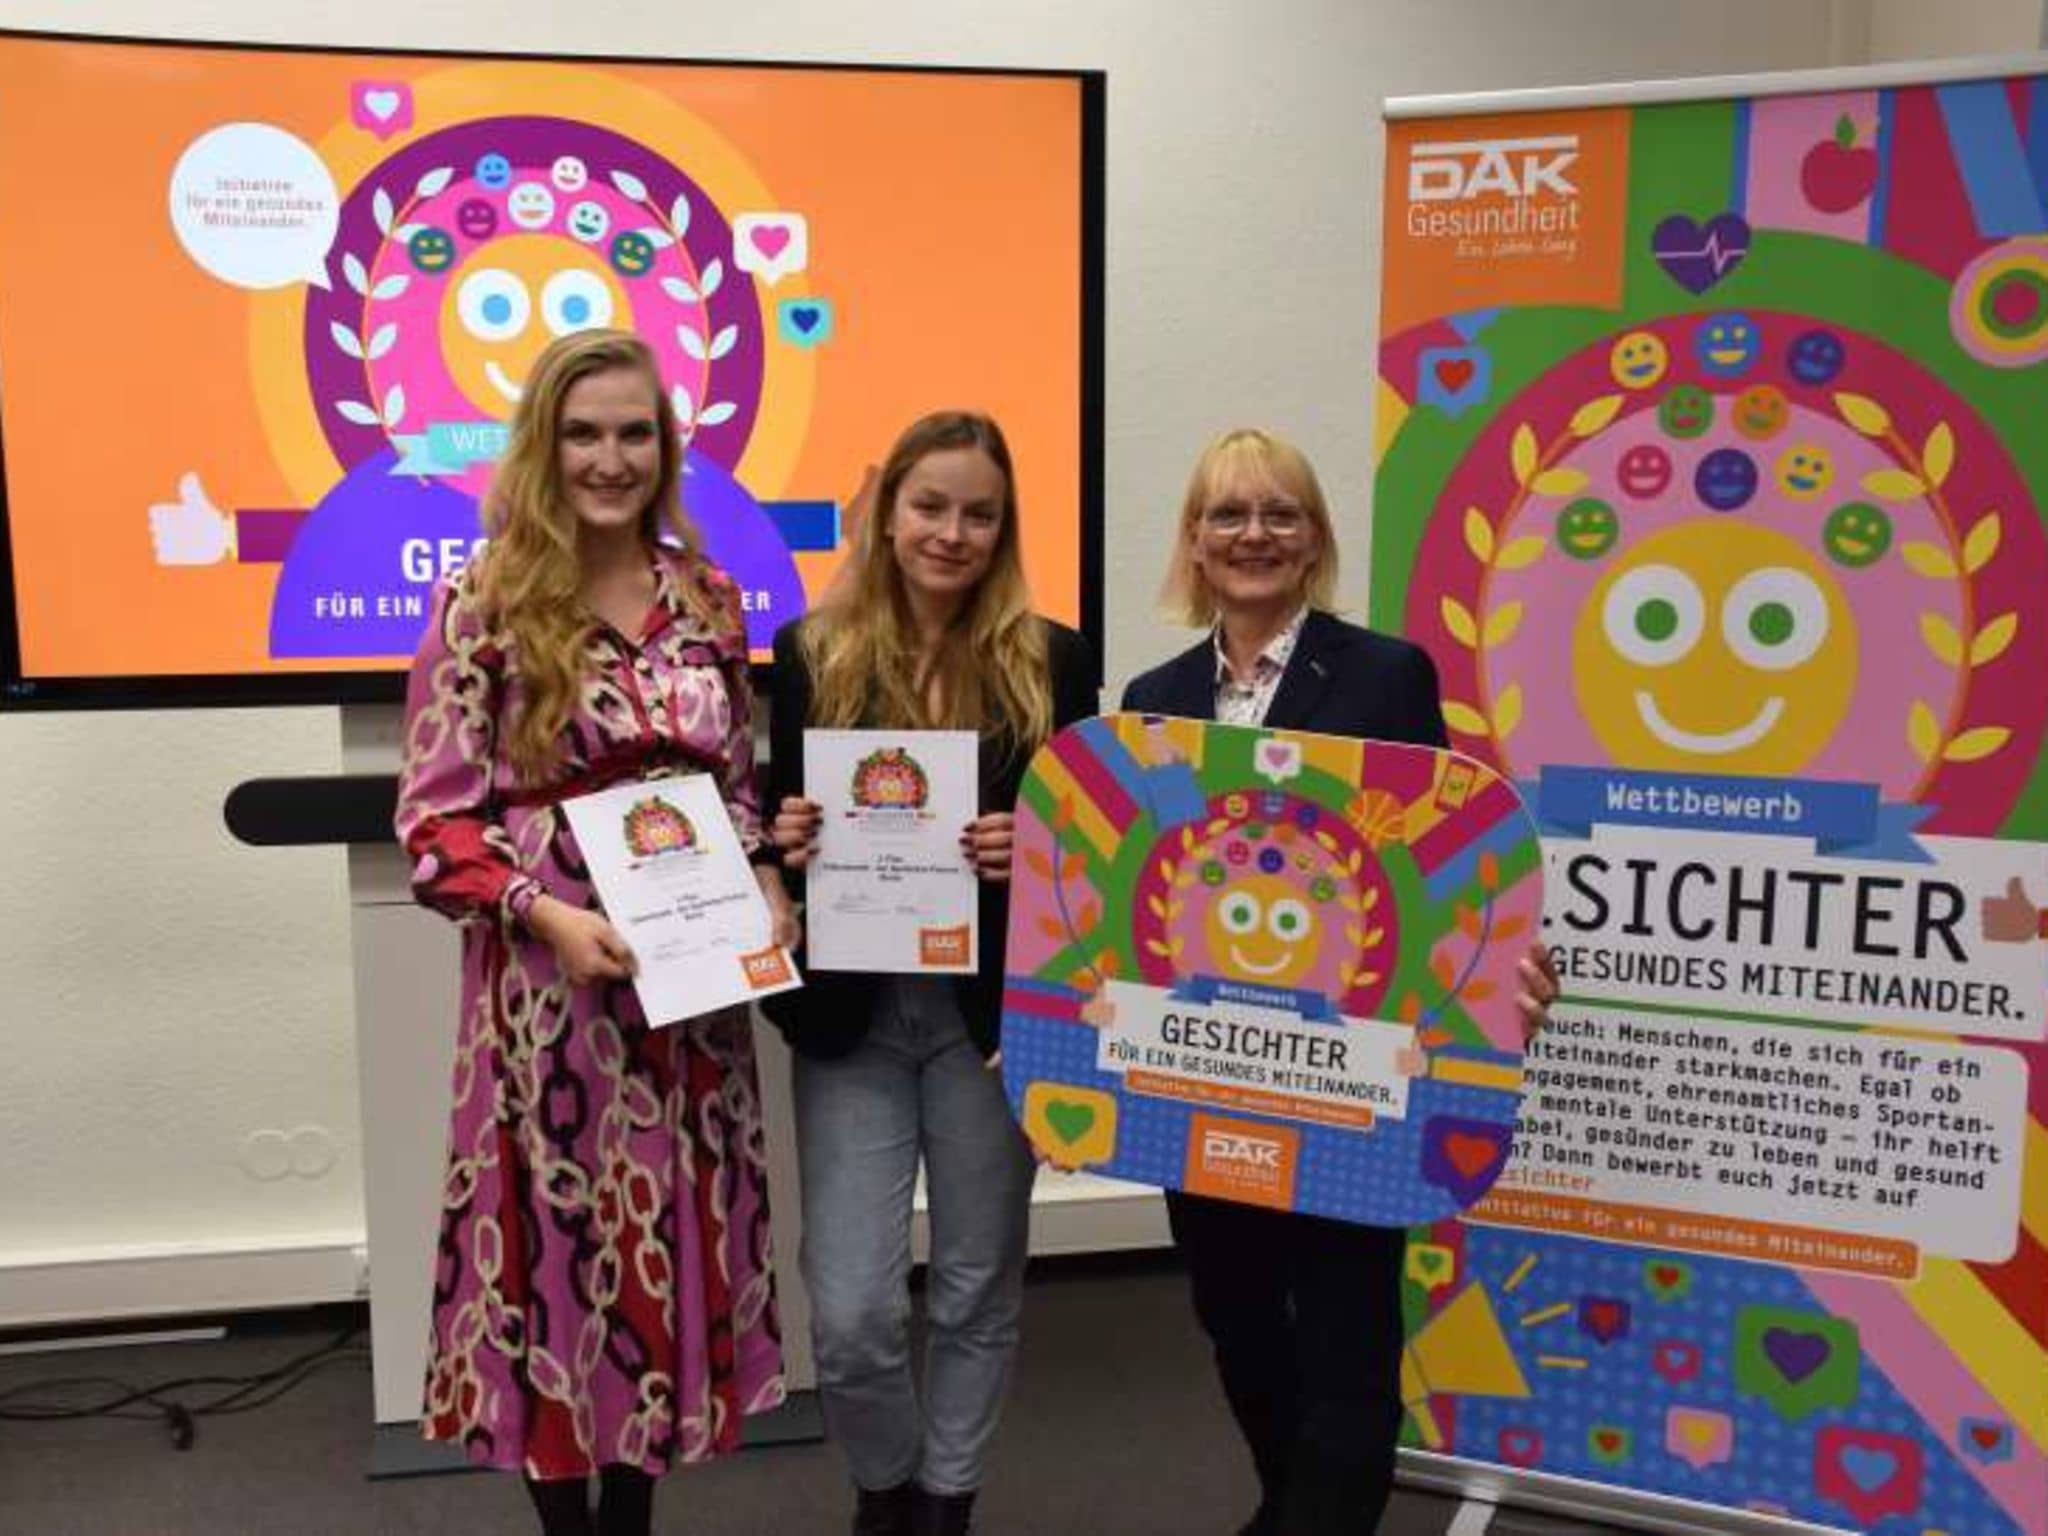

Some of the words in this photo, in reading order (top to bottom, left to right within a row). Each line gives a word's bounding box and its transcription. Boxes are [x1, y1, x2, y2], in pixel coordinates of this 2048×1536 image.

[1408, 134, 1579, 201] DAK
[1407, 198, 1578, 236] Gesundheit
[316, 594, 364, 618] FÜR
[378, 596, 422, 617] EIN
[1606, 783, 1803, 822] Wettbewerb
[1543, 853, 1969, 965] SICHTER
[1743, 962, 2027, 1021] MITEINANDER.
[1145, 1045, 1177, 1066] EIN
[1181, 1054, 1267, 1084] GESUNDES
[1160, 1013, 1348, 1072] GESICHTER
[1752, 1036, 1792, 1058] die
[1808, 1040, 1863, 1066] sich
[1879, 1049, 1922, 1073] für
[1937, 1058, 1981, 1078] ein
[1674, 1055, 1841, 1092] starkmachen.
[1860, 1075, 1912, 1100] Egal
[1931, 1083, 1961, 1103] ob
[1540, 1095, 1632, 1120] mentale
[1646, 1104, 1828, 1146] Unterstützung
[1928, 1137, 2002, 1164] helft
[1666, 1081, 1860, 1120] ehrenamtliches
[1877, 1103, 1995, 1133] Sportan-
[1205, 1131, 1282, 1168] DAK
[1543, 1143, 1593, 1166] Dann
[1606, 1151, 1703, 1180] bewerbt
[1717, 1168, 1773, 1189] euch
[1787, 1174, 1859, 1200] jetzt
[1875, 1188, 1919, 1208] auf
[1585, 1125, 1694, 1153] gesünder
[1708, 1140, 1735, 1158] zu
[1752, 1141, 1819, 1169] leben
[1835, 1155, 1879, 1177] und
[1895, 1161, 1985, 1190] gesund
